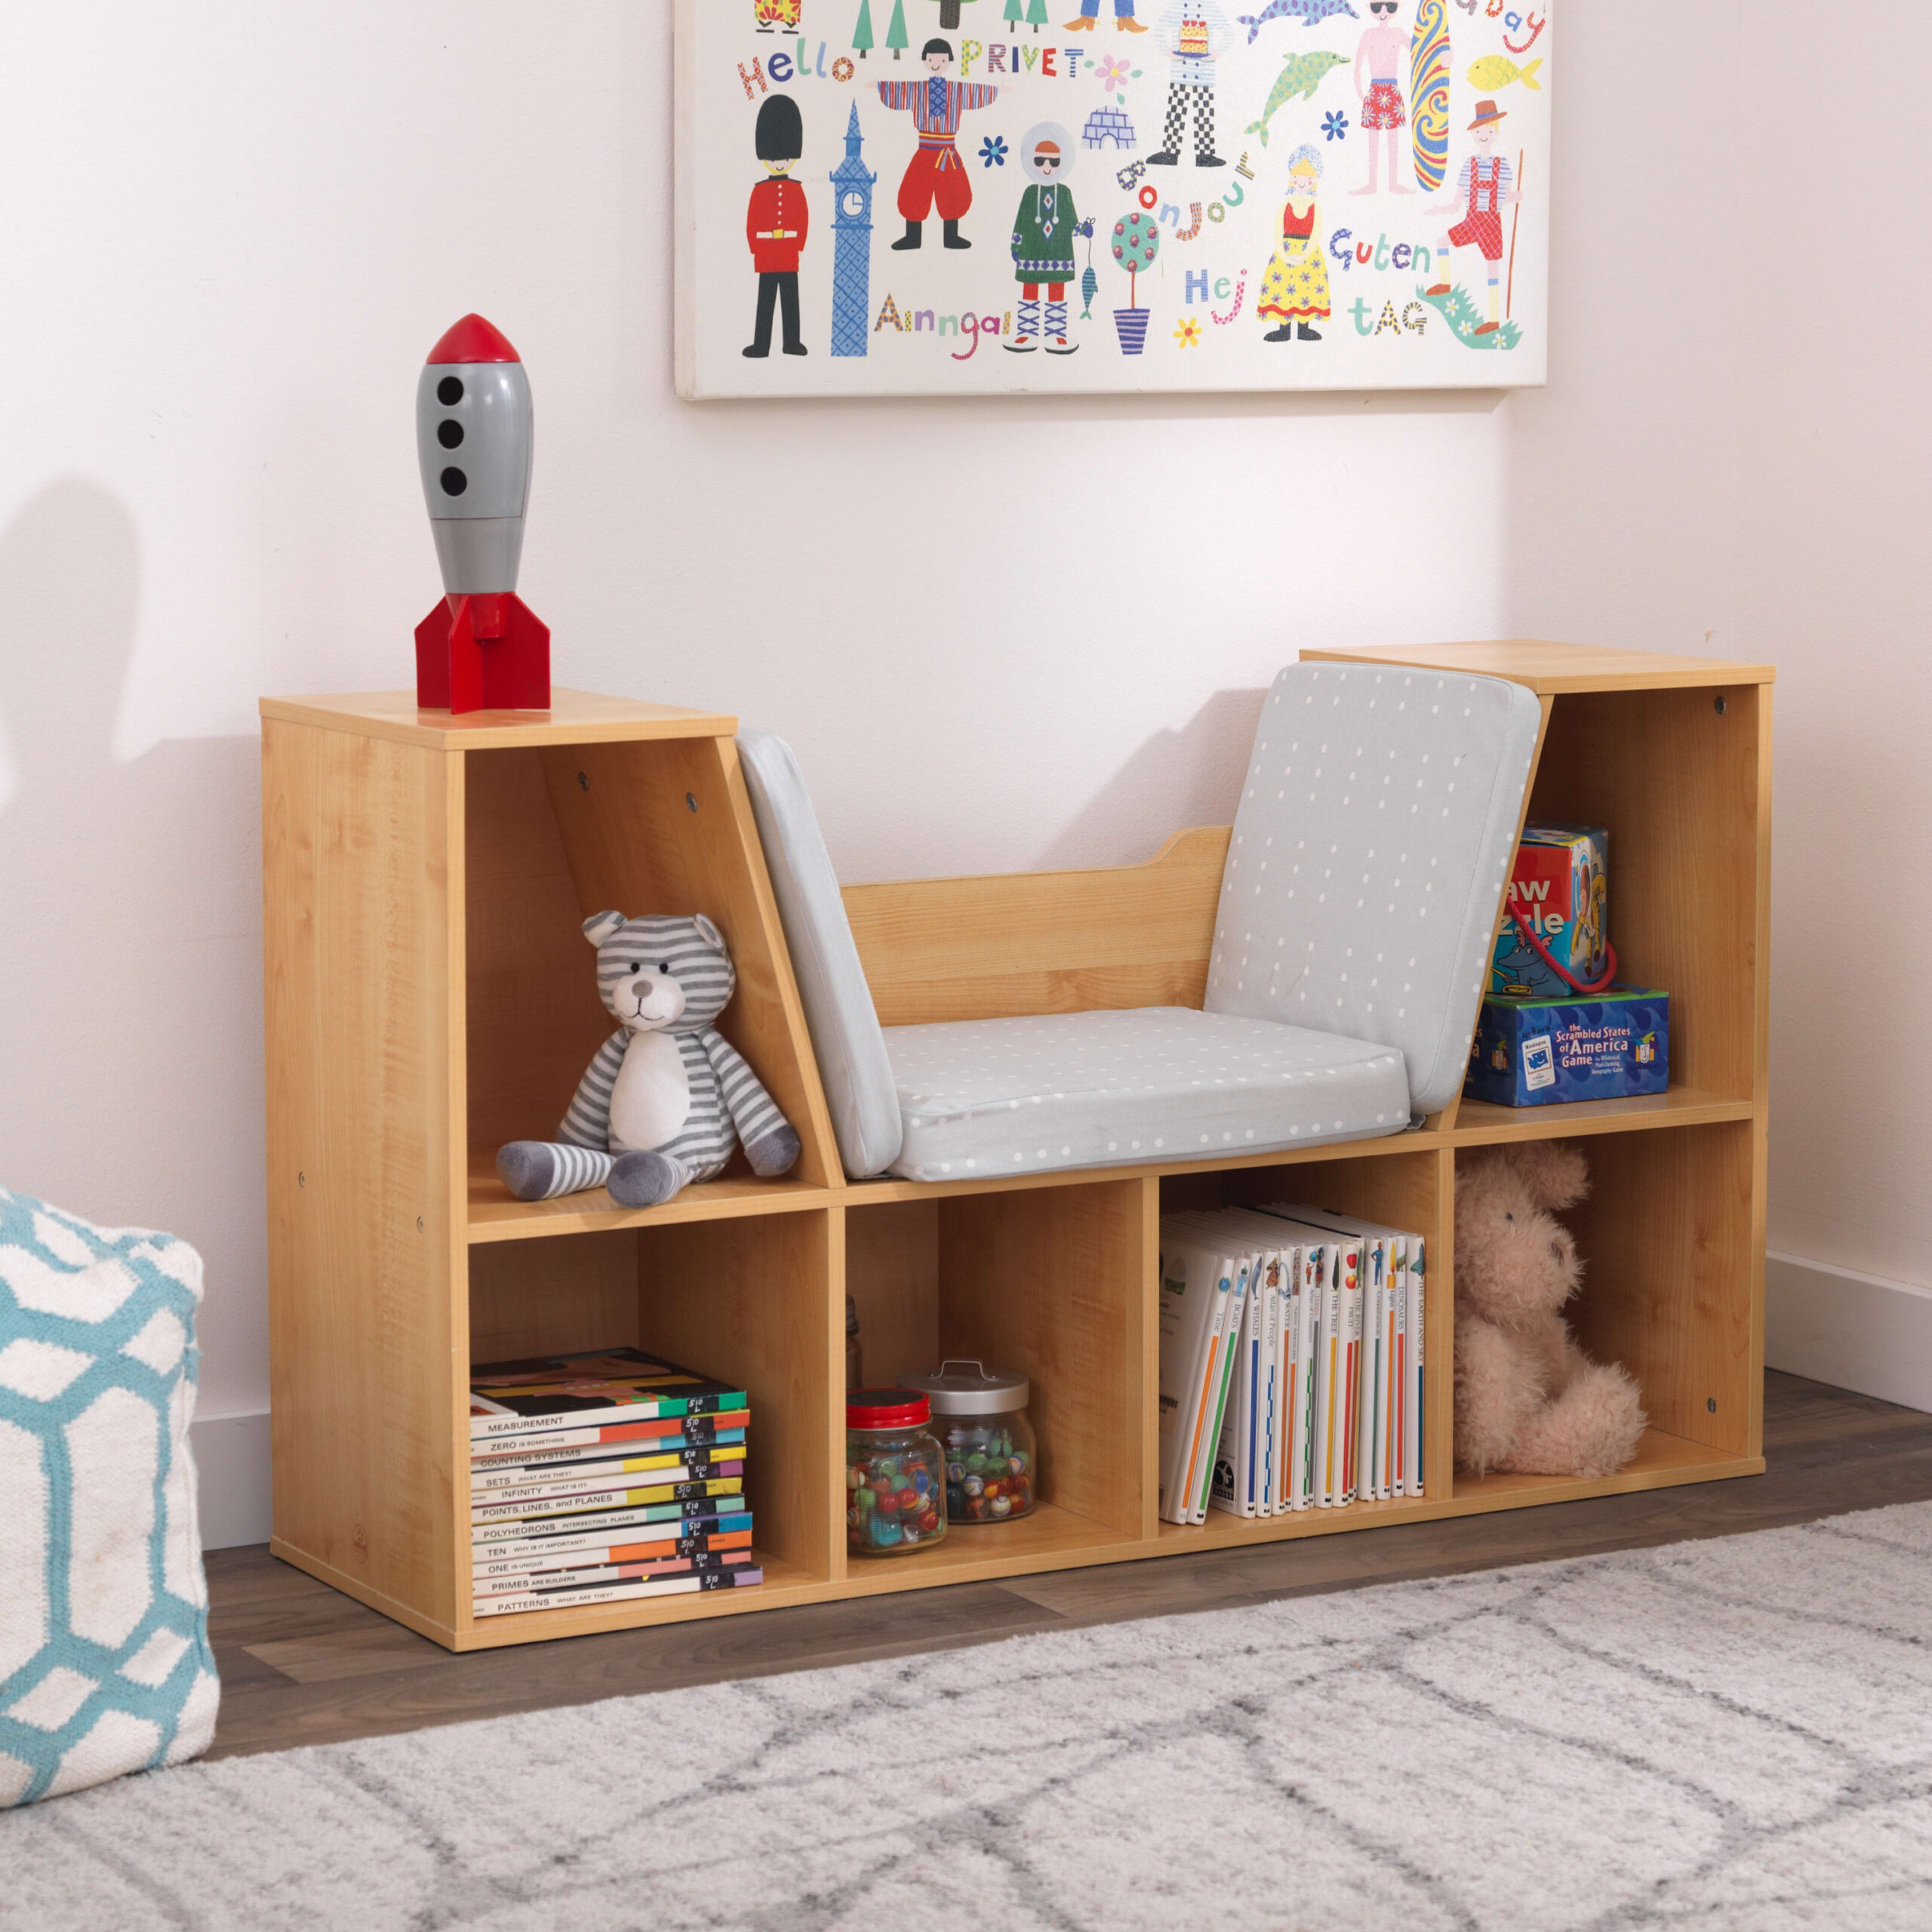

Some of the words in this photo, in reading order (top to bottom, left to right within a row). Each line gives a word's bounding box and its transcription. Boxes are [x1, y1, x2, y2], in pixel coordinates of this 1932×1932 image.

[961, 39, 1084, 77] PRIVET
[737, 37, 856, 100] Hello
[1329, 227, 1431, 273] Guten
[1186, 268, 1247, 325] Hej
[1556, 1029, 1601, 1042] Scrambled
[1603, 1026, 1630, 1038] States
[1559, 1043, 1569, 1052] of
[1570, 1038, 1628, 1055] America
[1562, 1056, 1592, 1068] Game
[1214, 1312, 1224, 1333] Time
[1231, 1304, 1241, 1328] BOATS
[488, 1417, 564, 1432] MEASUREMENT
[491, 1442, 516, 1451] ZERO
[527, 1437, 565, 1447] SOMETHING
[480, 1455, 531, 1468] COUNTING
[534, 1449, 581, 1461] SYSTEMS
[486, 1477, 511, 1487] SETS
[501, 1487, 543, 1499] INFINITY
[482, 1505, 521, 1517] POINTS,
[523, 1502, 553, 1515] LINES,
[555, 1499, 572, 1508] and
[575, 1494, 613, 1506] PLANES
[484, 1523, 555, 1538] POLYHEDRONS
[562, 1518, 607, 1528] INTERSECTING
[487, 1548, 506, 1556] TEN
[545, 1540, 586, 1549] IMPORTANT?
[488, 1564, 509, 1574] ONE
[519, 1561, 543, 1569] UNIQUE
[492, 1580, 529, 1591] PRIMES
[546, 1576, 576, 1584] BUILDERS
[497, 1598, 549, 1612] PATTERNS
